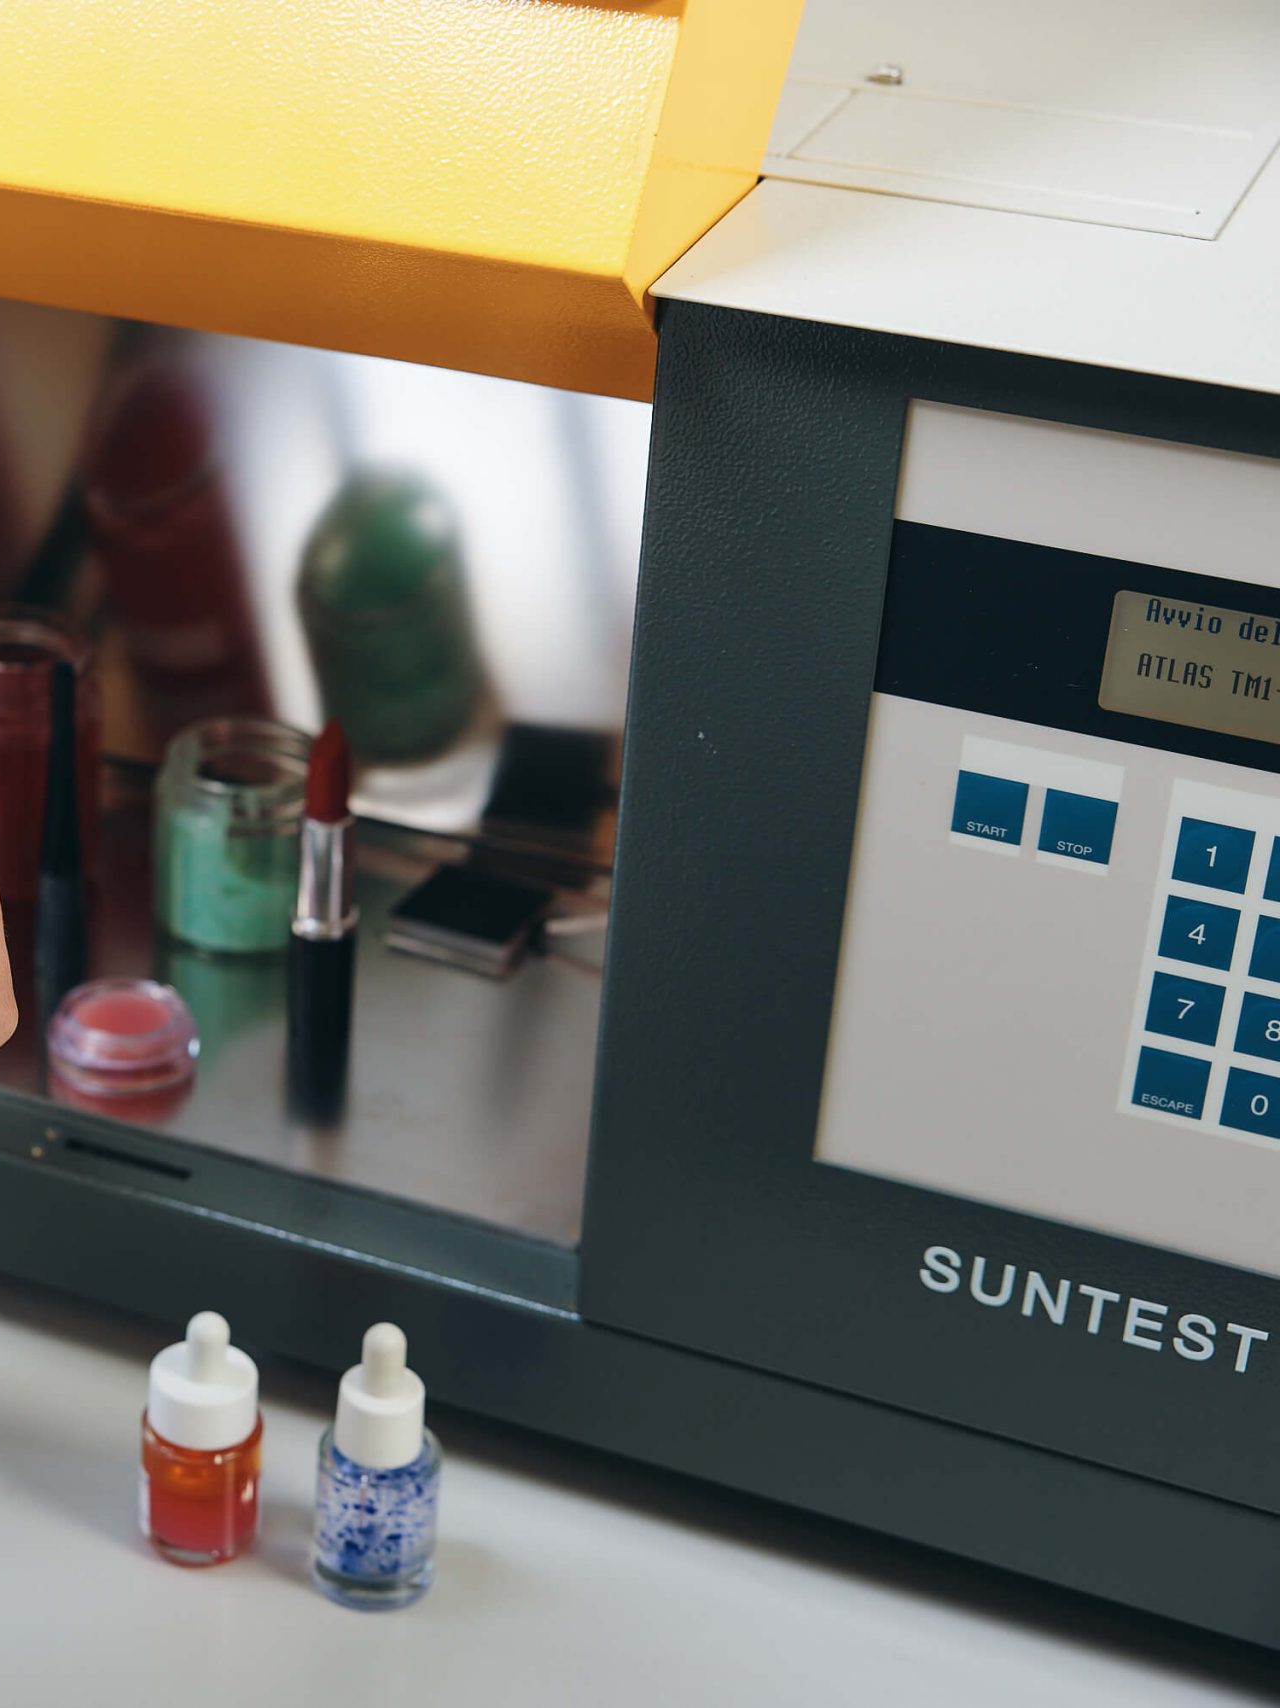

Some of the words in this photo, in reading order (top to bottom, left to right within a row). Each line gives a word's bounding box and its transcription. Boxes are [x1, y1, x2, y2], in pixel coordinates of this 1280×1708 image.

[1146, 598, 1222, 634] Avvio
[1137, 653, 1214, 689] ATLAS
[966, 821, 1008, 838] START
[1056, 840, 1093, 856] STOP
[1206, 845, 1218, 867] 1
[1188, 923, 1206, 945] 4
[1177, 998, 1195, 1020] 7
[1265, 1019, 1280, 1042] 8
[1140, 1093, 1195, 1115] ESCAPE
[1250, 1094, 1269, 1117] 0
[919, 1245, 1270, 1374] SUNTEST
